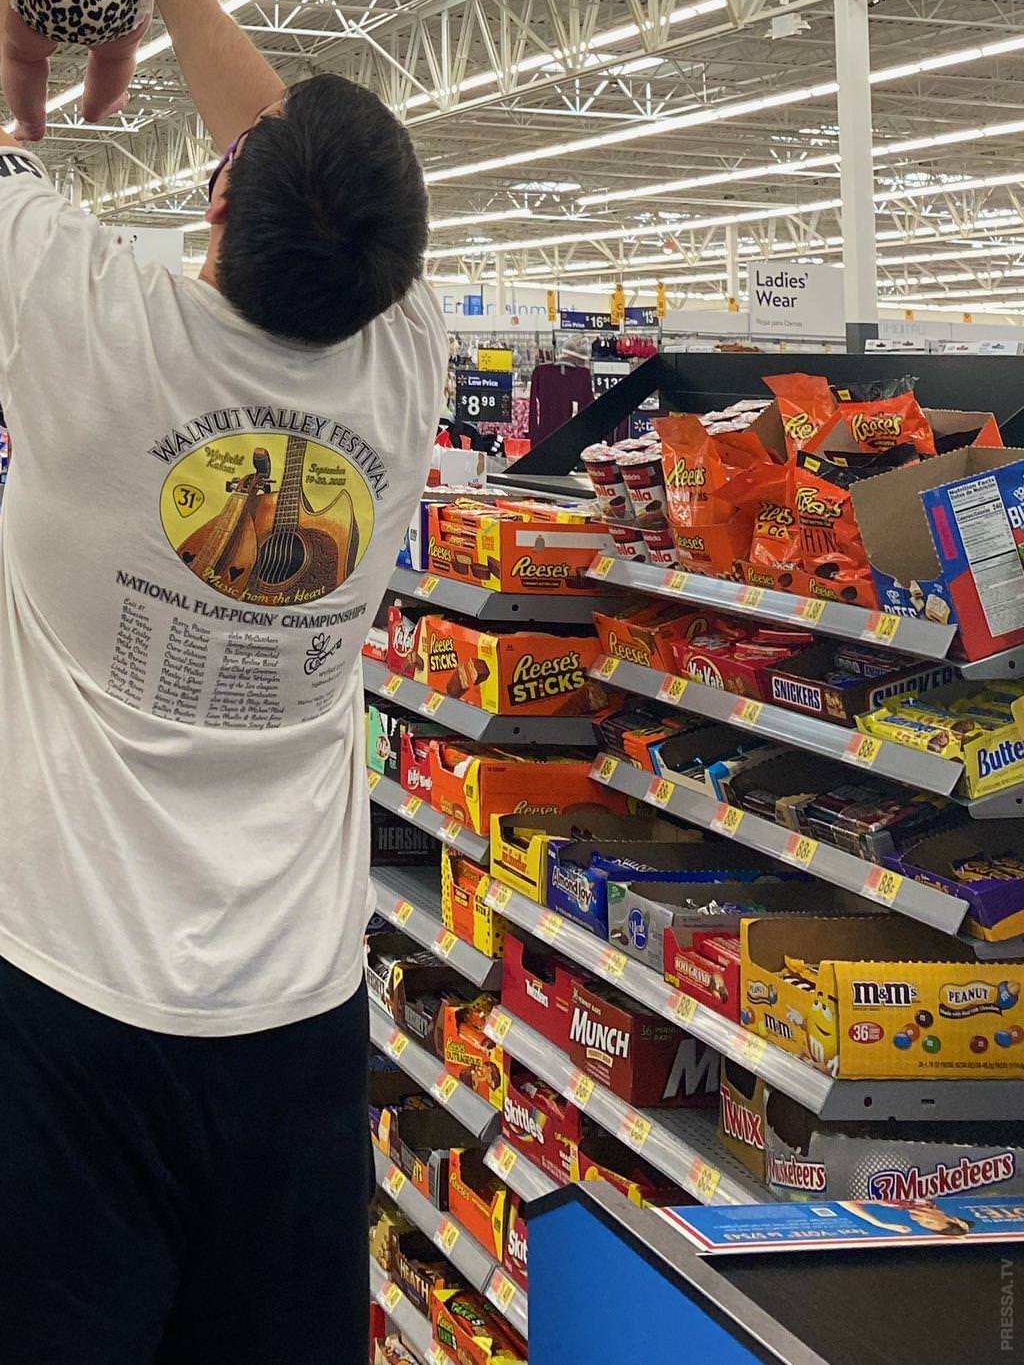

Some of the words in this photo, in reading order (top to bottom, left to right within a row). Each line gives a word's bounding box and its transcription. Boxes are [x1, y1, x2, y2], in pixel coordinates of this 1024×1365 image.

[756, 270, 809, 290] Ladies'
[756, 290, 798, 309] Wear
[482, 379, 499, 387] Price
[149, 407, 242, 466] WALNUT
[243, 406, 331, 437] VALLEY
[328, 421, 391, 501] FESTIVAL
[948, 483, 977, 496] Nutrition
[977, 477, 995, 486] Facts
[512, 556, 570, 579] Reese's
[115, 570, 190, 610] NATIONAL
[193, 598, 279, 627] FLAT-PICKIN'
[281, 602, 369, 630] CHAMPIONSHIPS
[202, 567, 238, 598] Music
[241, 591, 269, 604] from
[273, 591, 292, 604] the
[294, 585, 326, 601] Heart
[430, 634, 454, 654] Reese's
[609, 631, 651, 668] Reese's
[513, 652, 580, 683] Reese's
[773, 678, 821, 710] SNICKERS
[552, 865, 579, 896] Almond
[948, 987, 989, 1003] PEANUT
[570, 1008, 630, 1058] MUNCH
[853, 1024, 868, 1041] 36
[503, 1097, 545, 1145] Skittles
[720, 1085, 764, 1150] TWIX
[869, 1170, 897, 1202] 3
[895, 1152, 1014, 1202] Musketeers
[399, 1257, 429, 1297] HEATH
